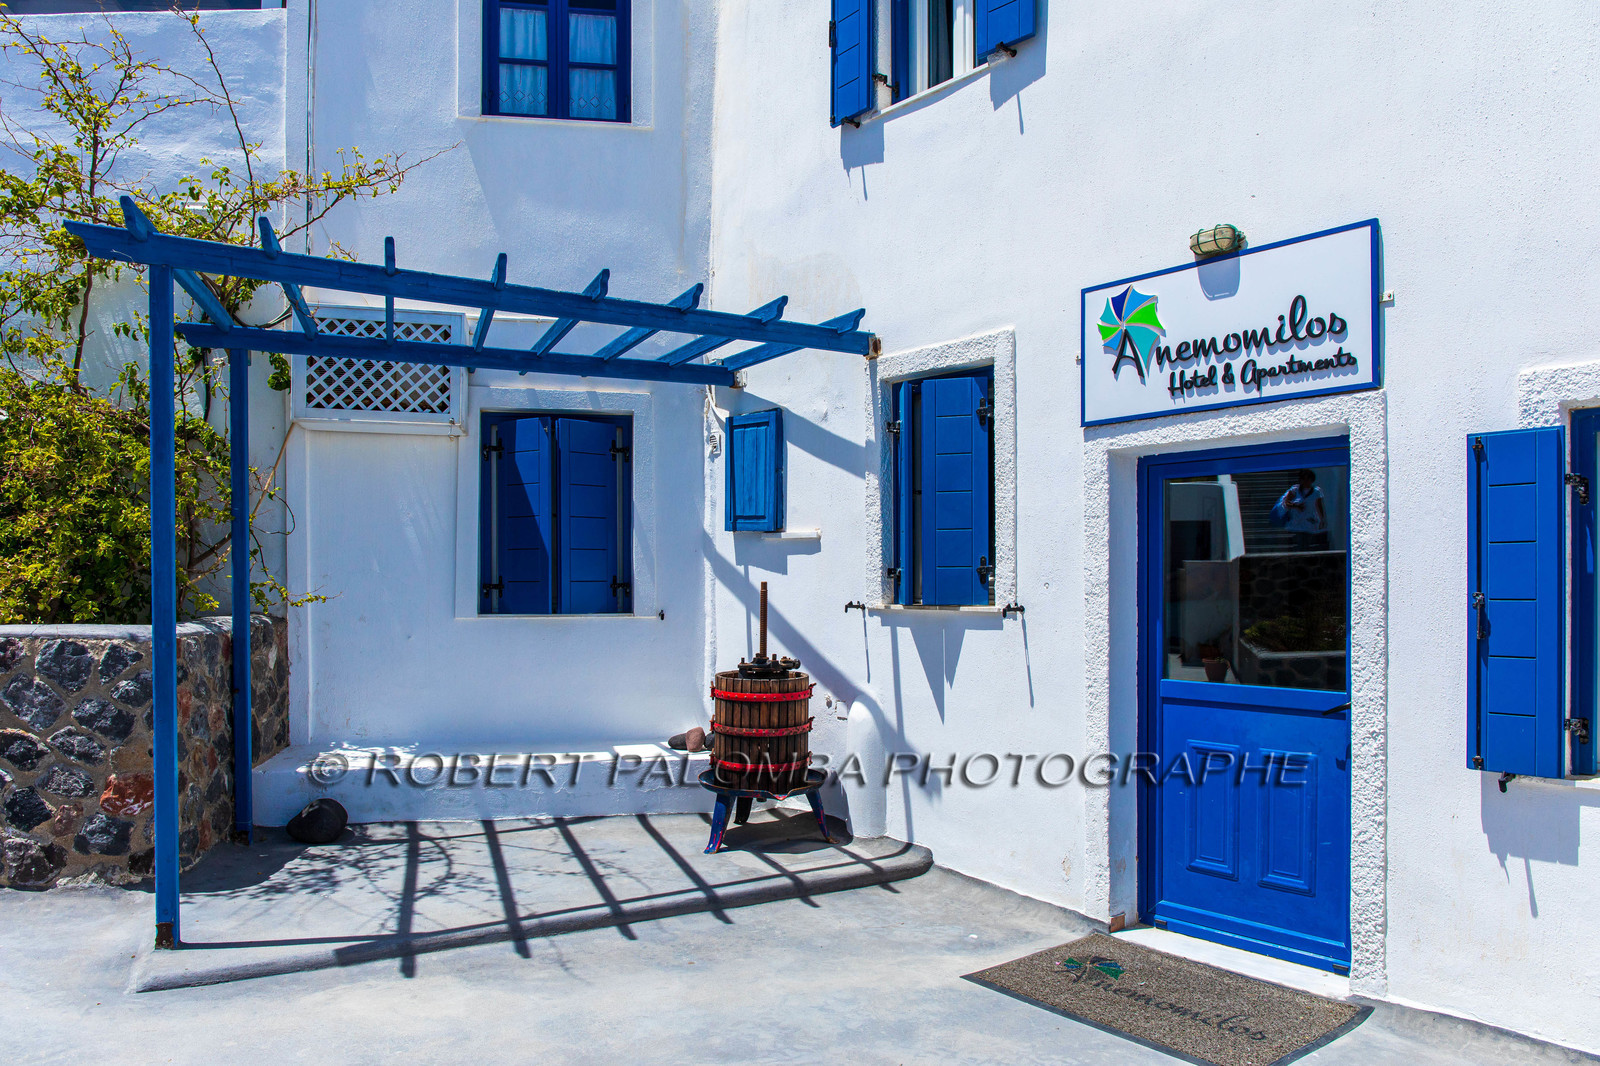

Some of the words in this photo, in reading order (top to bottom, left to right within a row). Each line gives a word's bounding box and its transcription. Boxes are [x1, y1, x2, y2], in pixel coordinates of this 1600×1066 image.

[1111, 294, 1348, 379] Anemomilos
[1168, 364, 1217, 397] Hotel
[1221, 365, 1235, 385] &
[1240, 346, 1358, 392] Apartments
